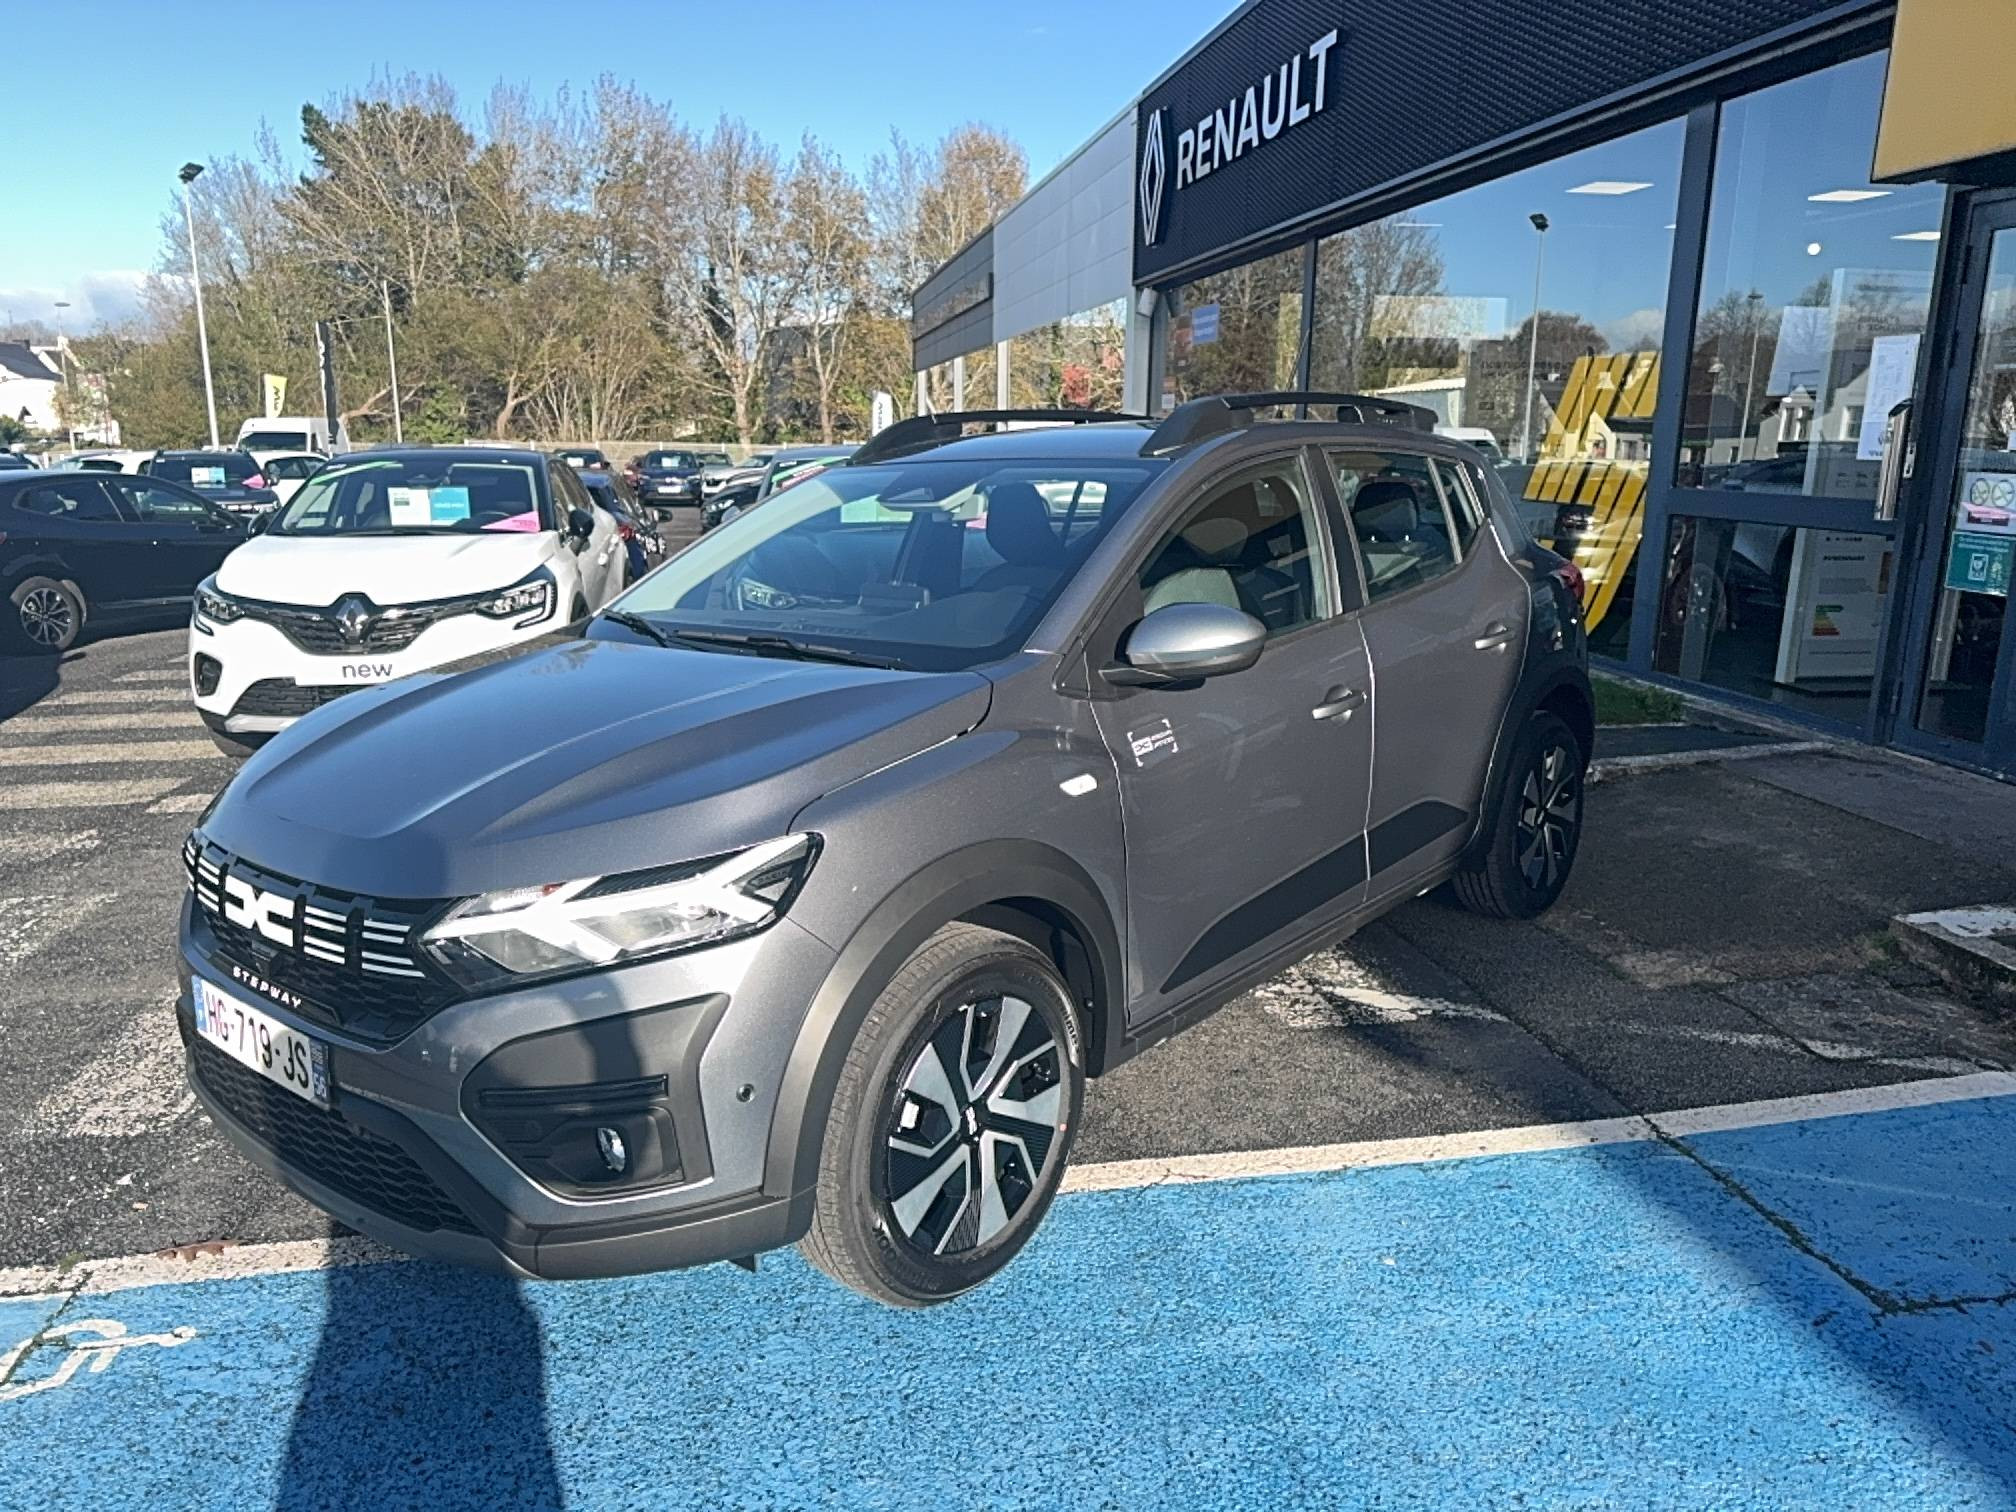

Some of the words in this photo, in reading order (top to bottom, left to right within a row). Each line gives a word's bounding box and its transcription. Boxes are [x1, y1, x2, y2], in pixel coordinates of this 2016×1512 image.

[1177, 28, 1338, 190] RENAULT
[342, 663, 393, 679] new
[233, 965, 302, 1009] STEPWAY
